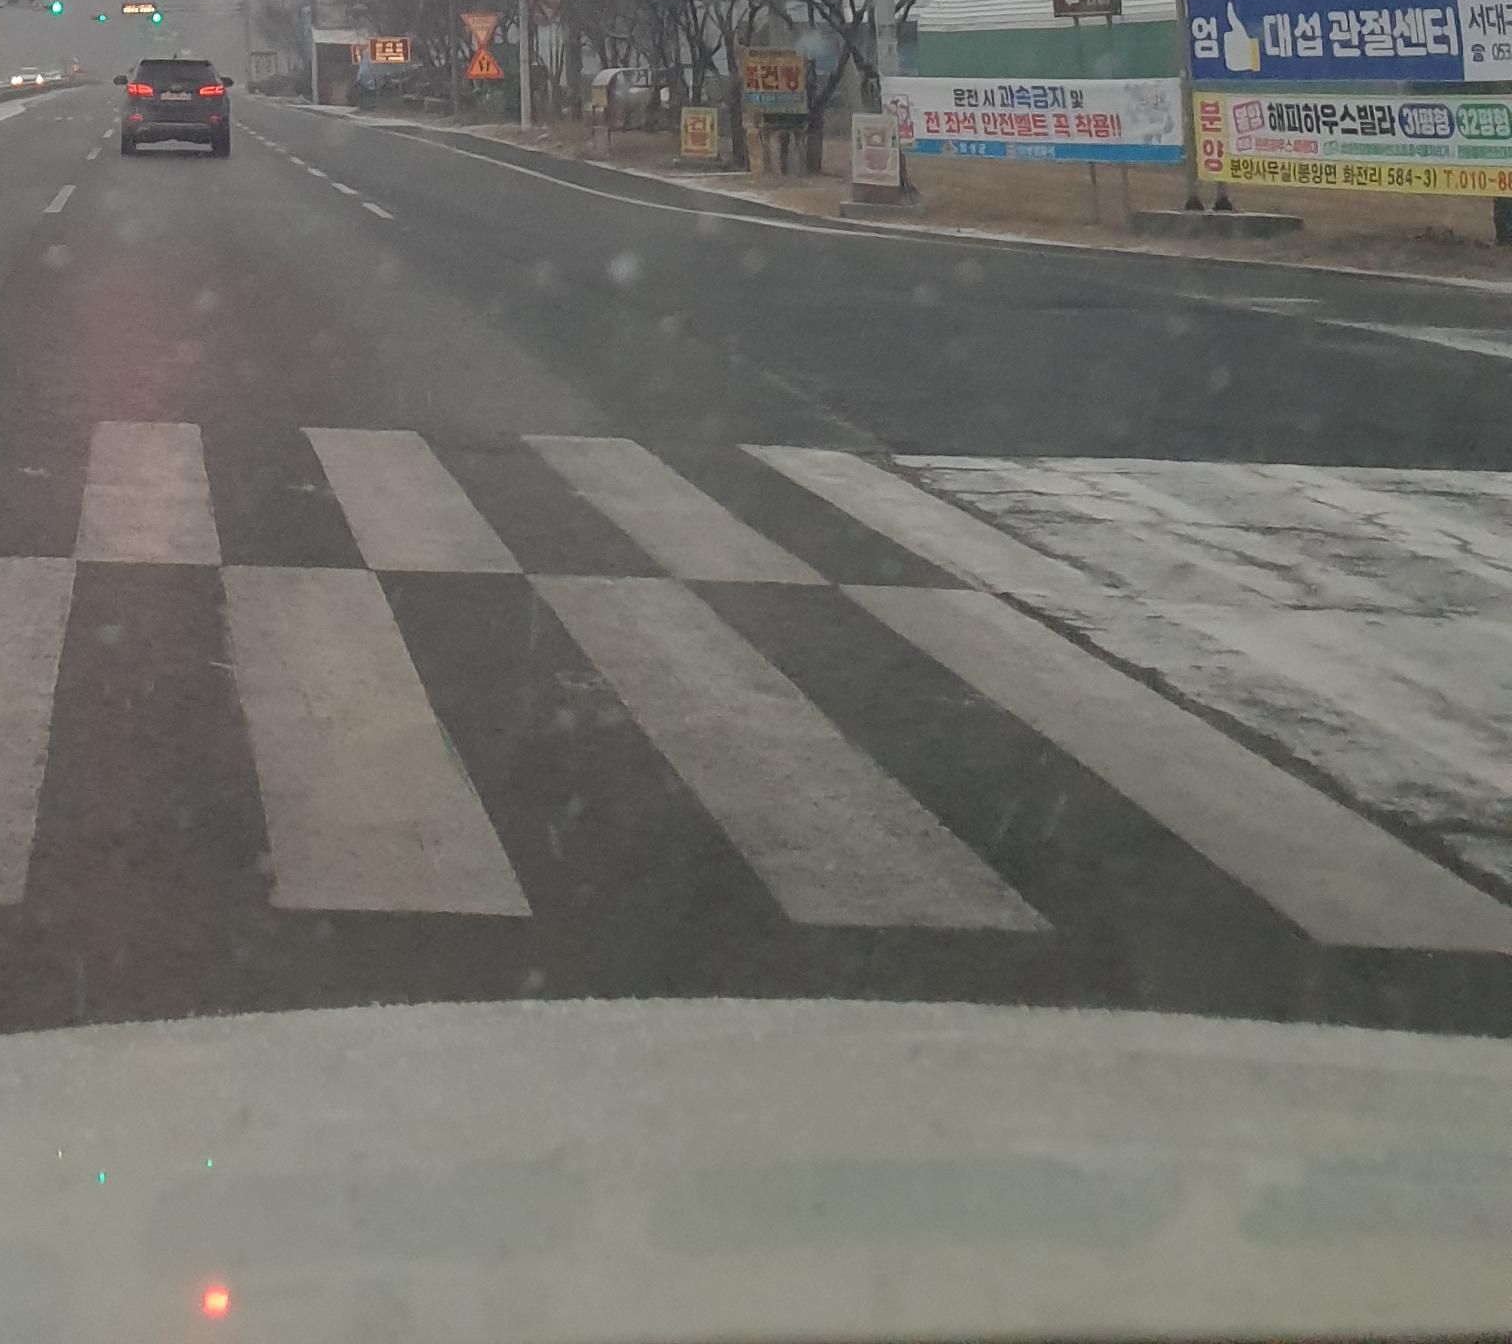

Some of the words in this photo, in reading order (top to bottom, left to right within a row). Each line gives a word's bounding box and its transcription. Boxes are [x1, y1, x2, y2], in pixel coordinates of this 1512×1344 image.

[1191, 16, 1219, 58] 엄
[1327, 6, 1459, 57] 관절센터
[953, 88, 979, 108] 운전
[983, 89, 996, 108] 시
[998, 85, 1067, 109] 과속금지
[1070, 90, 1084, 109] 및
[924, 111, 940, 134] 전
[944, 111, 978, 134] 좌석
[981, 112, 1048, 137] 안전벨트
[1052, 113, 1071, 138] 꼭
[1075, 112, 1122, 138] 착용!!
[1267, 102, 1397, 137] 해피하우스빌라
[1199, 100, 1224, 173] 분양
[1387, 166, 1438, 189] 584-3)
